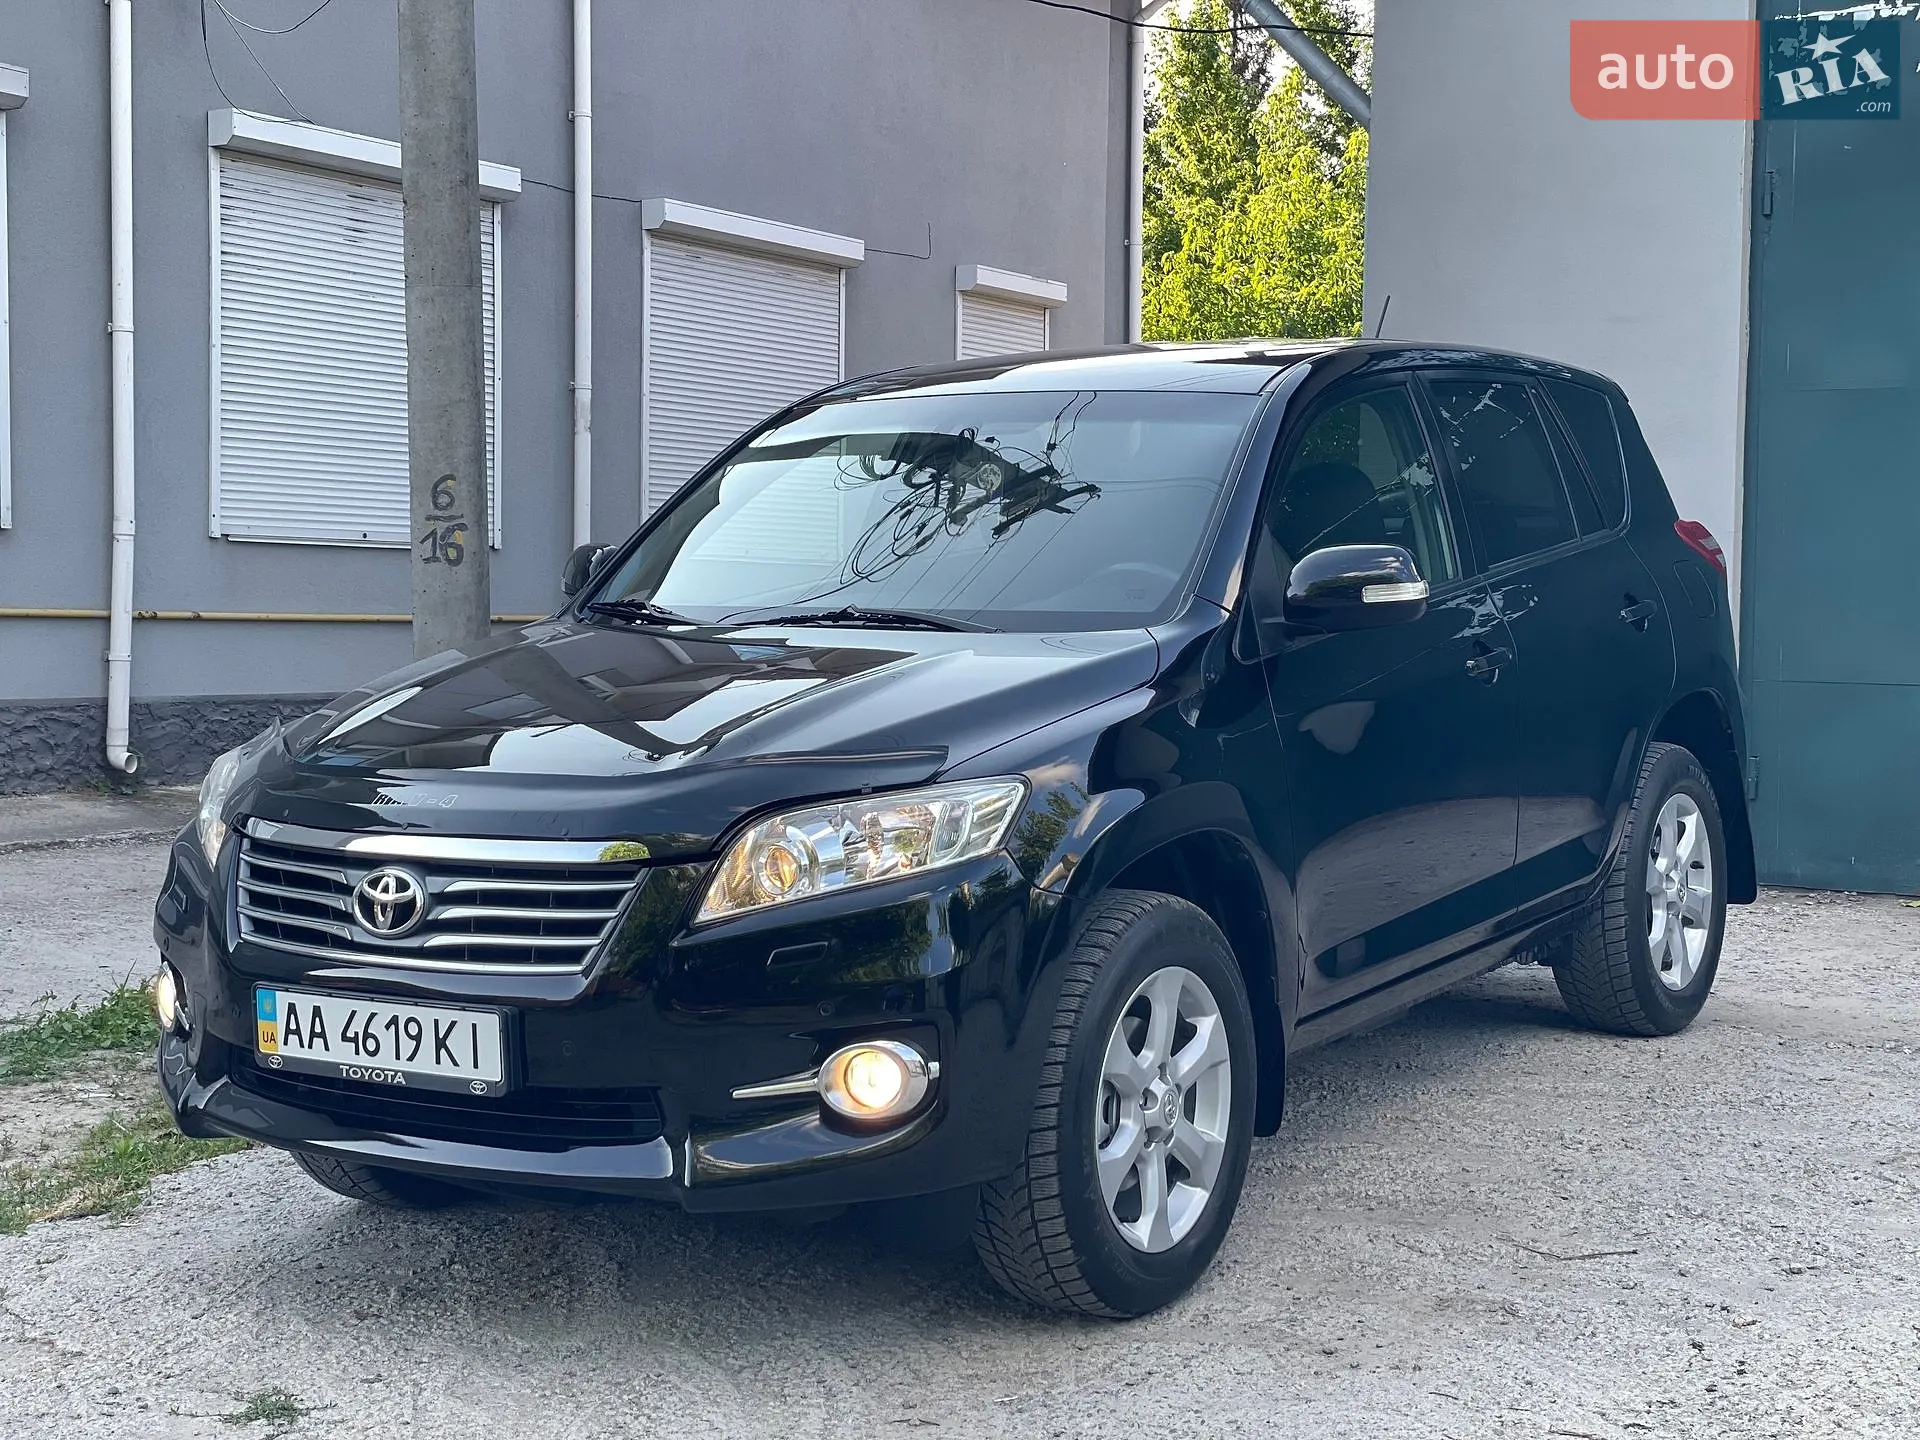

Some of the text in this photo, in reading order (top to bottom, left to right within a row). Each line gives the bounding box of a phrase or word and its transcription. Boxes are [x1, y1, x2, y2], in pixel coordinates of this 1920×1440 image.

[430, 473, 457, 511] 6
[419, 522, 469, 567] 16
[262, 1030, 277, 1045] UA
[283, 1001, 479, 1069] AA 4619 KI
[339, 1064, 407, 1085] TOYOTA
